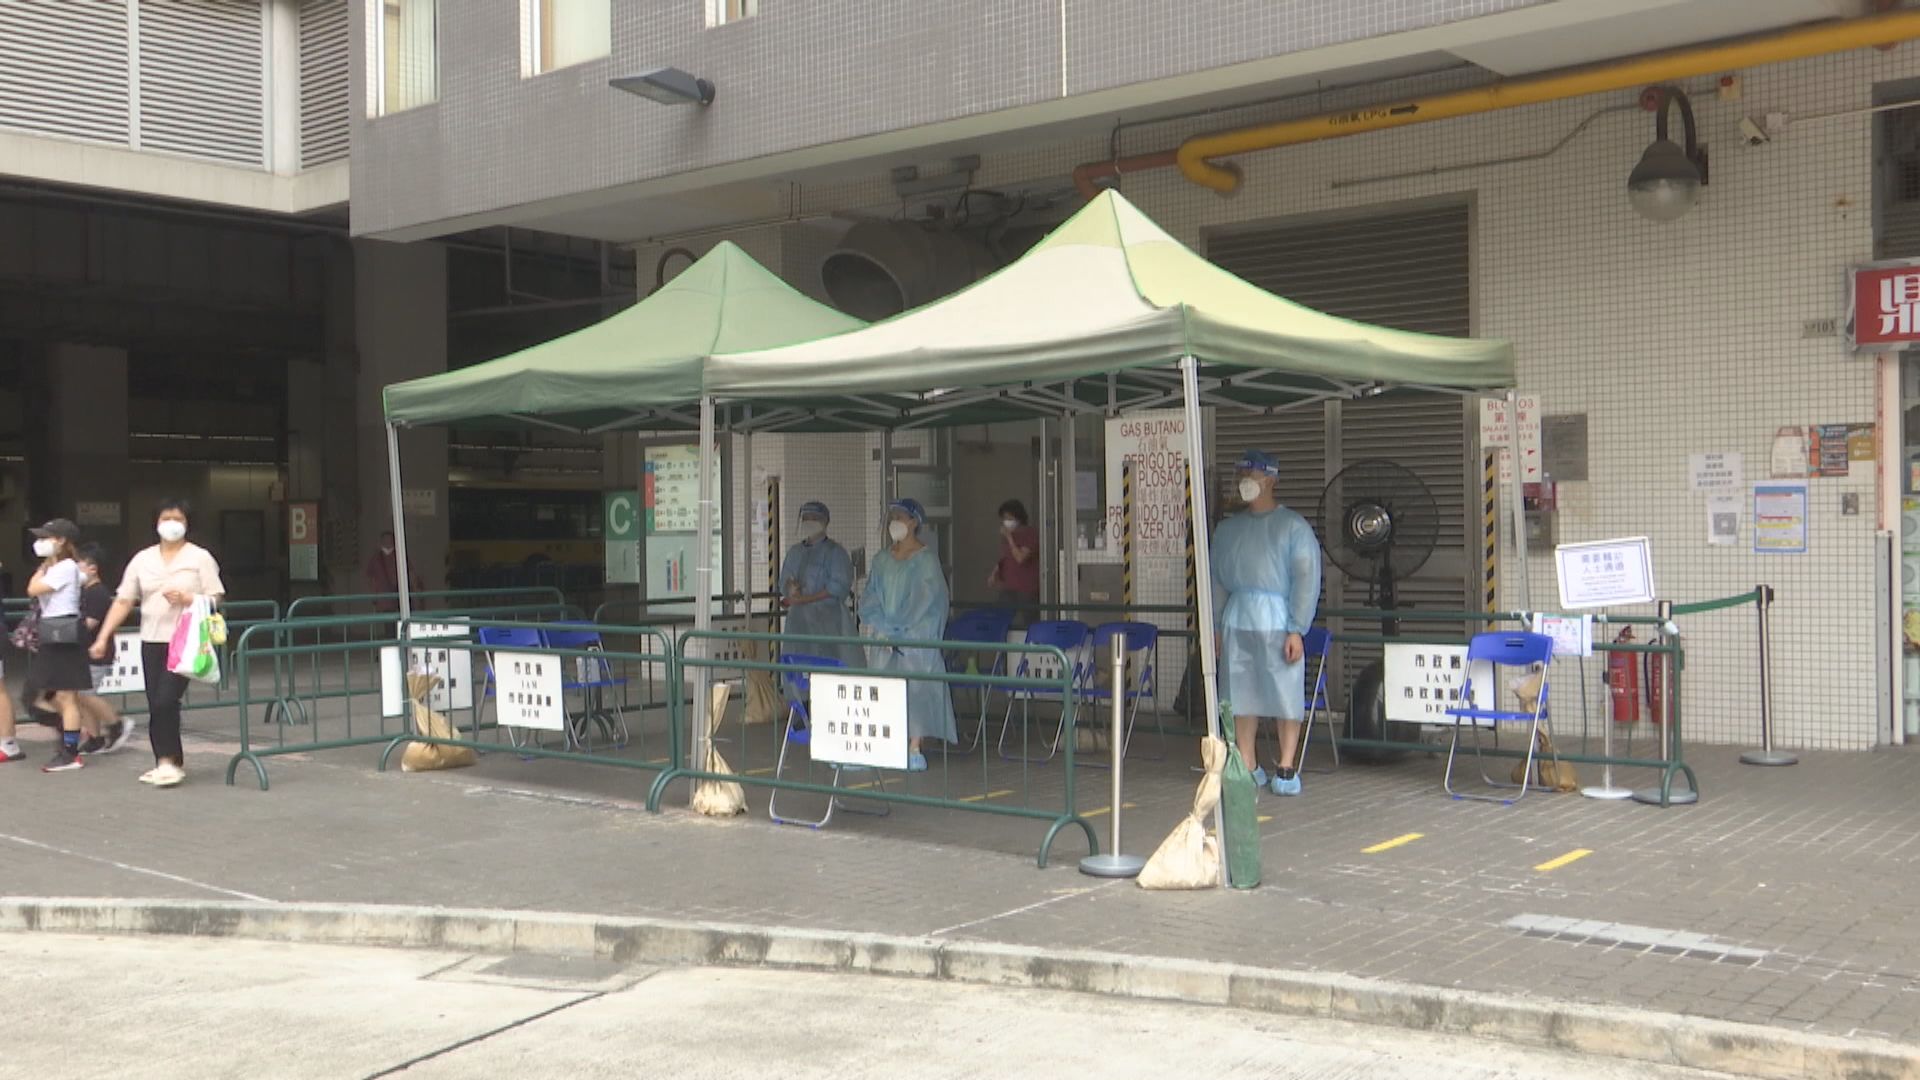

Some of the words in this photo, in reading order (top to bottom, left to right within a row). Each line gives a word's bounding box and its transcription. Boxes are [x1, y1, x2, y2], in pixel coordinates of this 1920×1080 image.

[1120, 423, 1141, 437] GAS
[1144, 420, 1185, 435] BUTANO
[1167, 451, 1182, 469] DE
[292, 508, 307, 539] B
[609, 497, 631, 534] C
[1415, 654, 1461, 669] 市政署
[1426, 672, 1452, 684] IAM
[837, 684, 879, 702] 市政署
[847, 705, 871, 718] IAM
[845, 740, 872, 753] DEM
